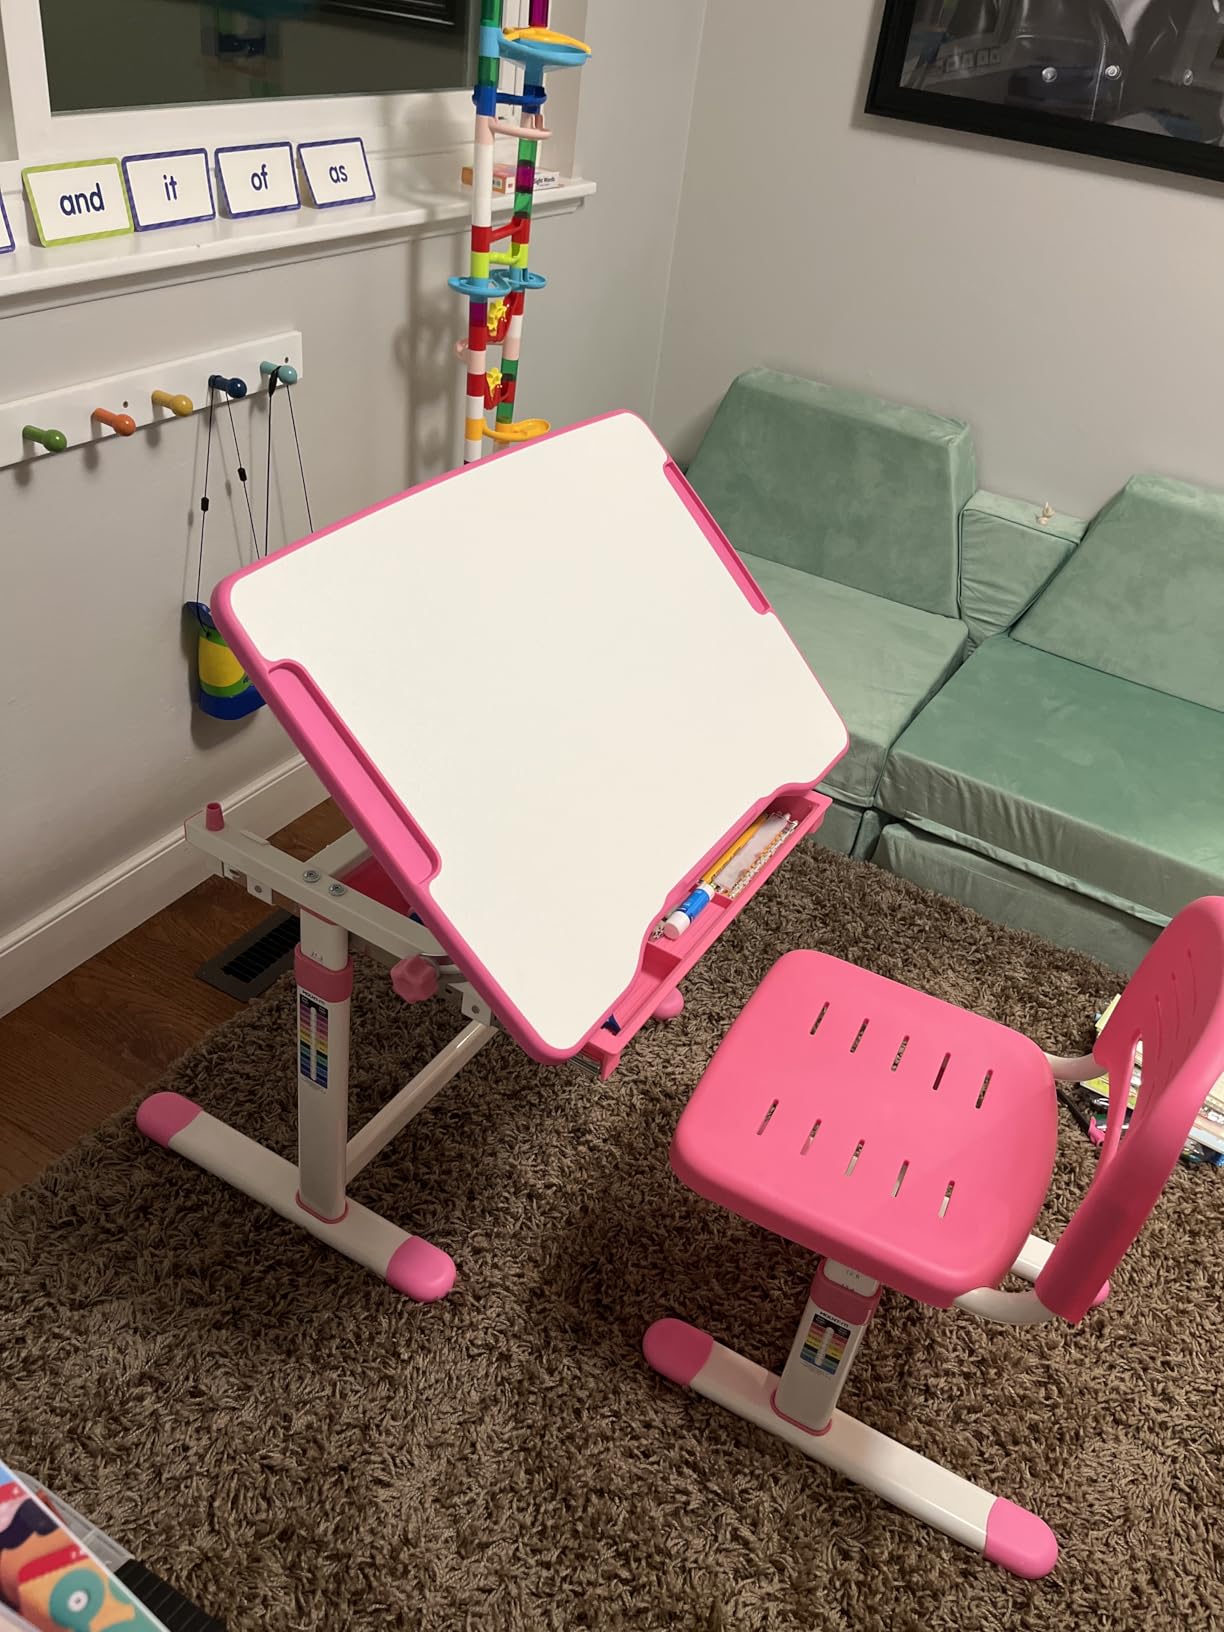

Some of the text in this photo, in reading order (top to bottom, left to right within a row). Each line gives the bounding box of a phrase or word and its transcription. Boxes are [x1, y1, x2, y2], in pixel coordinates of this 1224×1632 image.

[163, 174, 178, 201] it
[250, 163, 268, 191] of
[329, 164, 348, 184] as
[59, 183, 105, 216] and
